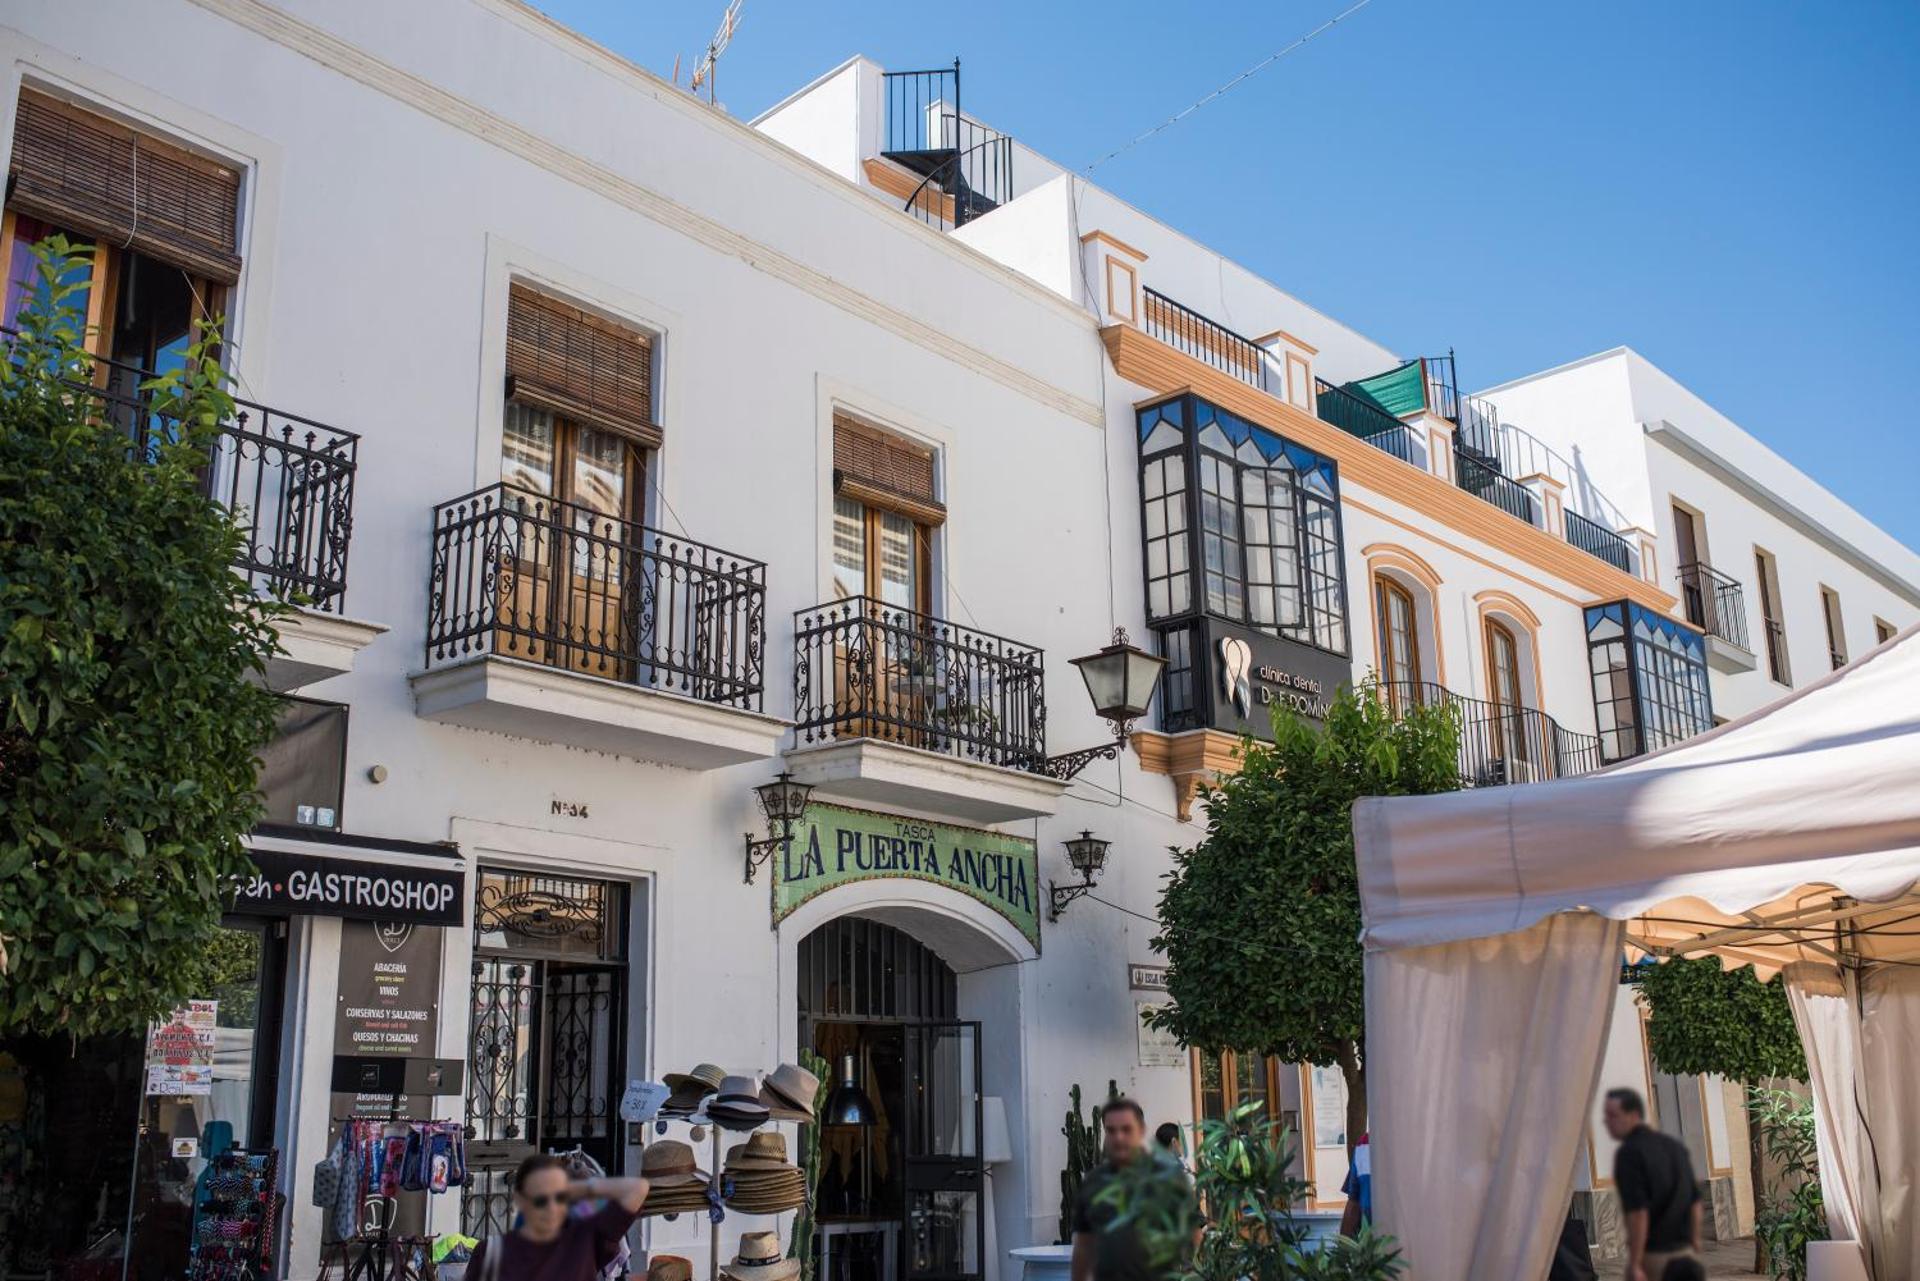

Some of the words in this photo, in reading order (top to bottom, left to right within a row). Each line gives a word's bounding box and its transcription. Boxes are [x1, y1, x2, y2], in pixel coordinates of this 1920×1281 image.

[1293, 675, 1322, 693] dental
[893, 822, 937, 843] TASCA
[783, 824, 825, 883] LA
[836, 828, 941, 876] PUERTA
[948, 847, 1033, 914] ANCHA
[288, 870, 454, 912] GASTROSHOP
[346, 1007, 385, 1018] CONSERVAS
[386, 1009, 391, 1019] Y
[352, 1031, 379, 1043] QUESOS
[380, 1032, 385, 1043] Y
